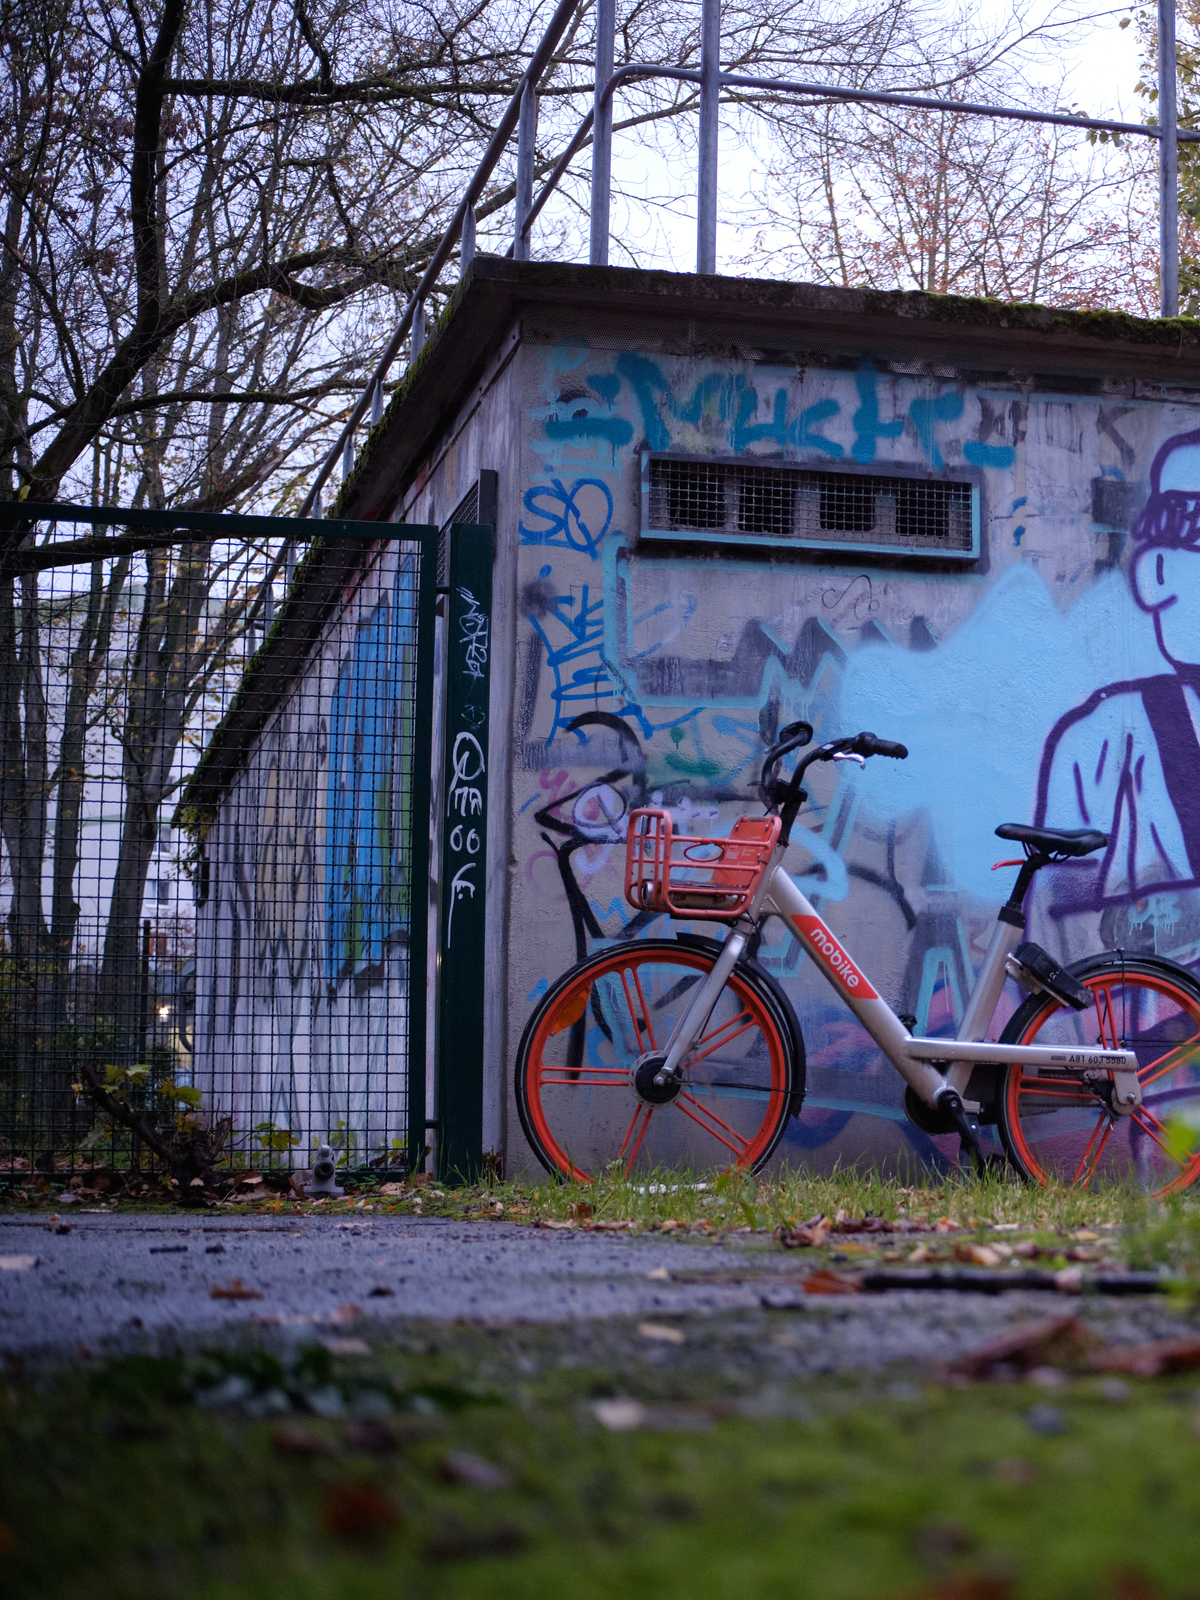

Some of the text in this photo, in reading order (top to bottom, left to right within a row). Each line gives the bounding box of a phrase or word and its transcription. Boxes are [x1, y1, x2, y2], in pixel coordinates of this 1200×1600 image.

[810, 928, 859, 988] mobike
[1068, 1054, 1085, 1063] A81
[1088, 1055, 1104, 1064] 603
